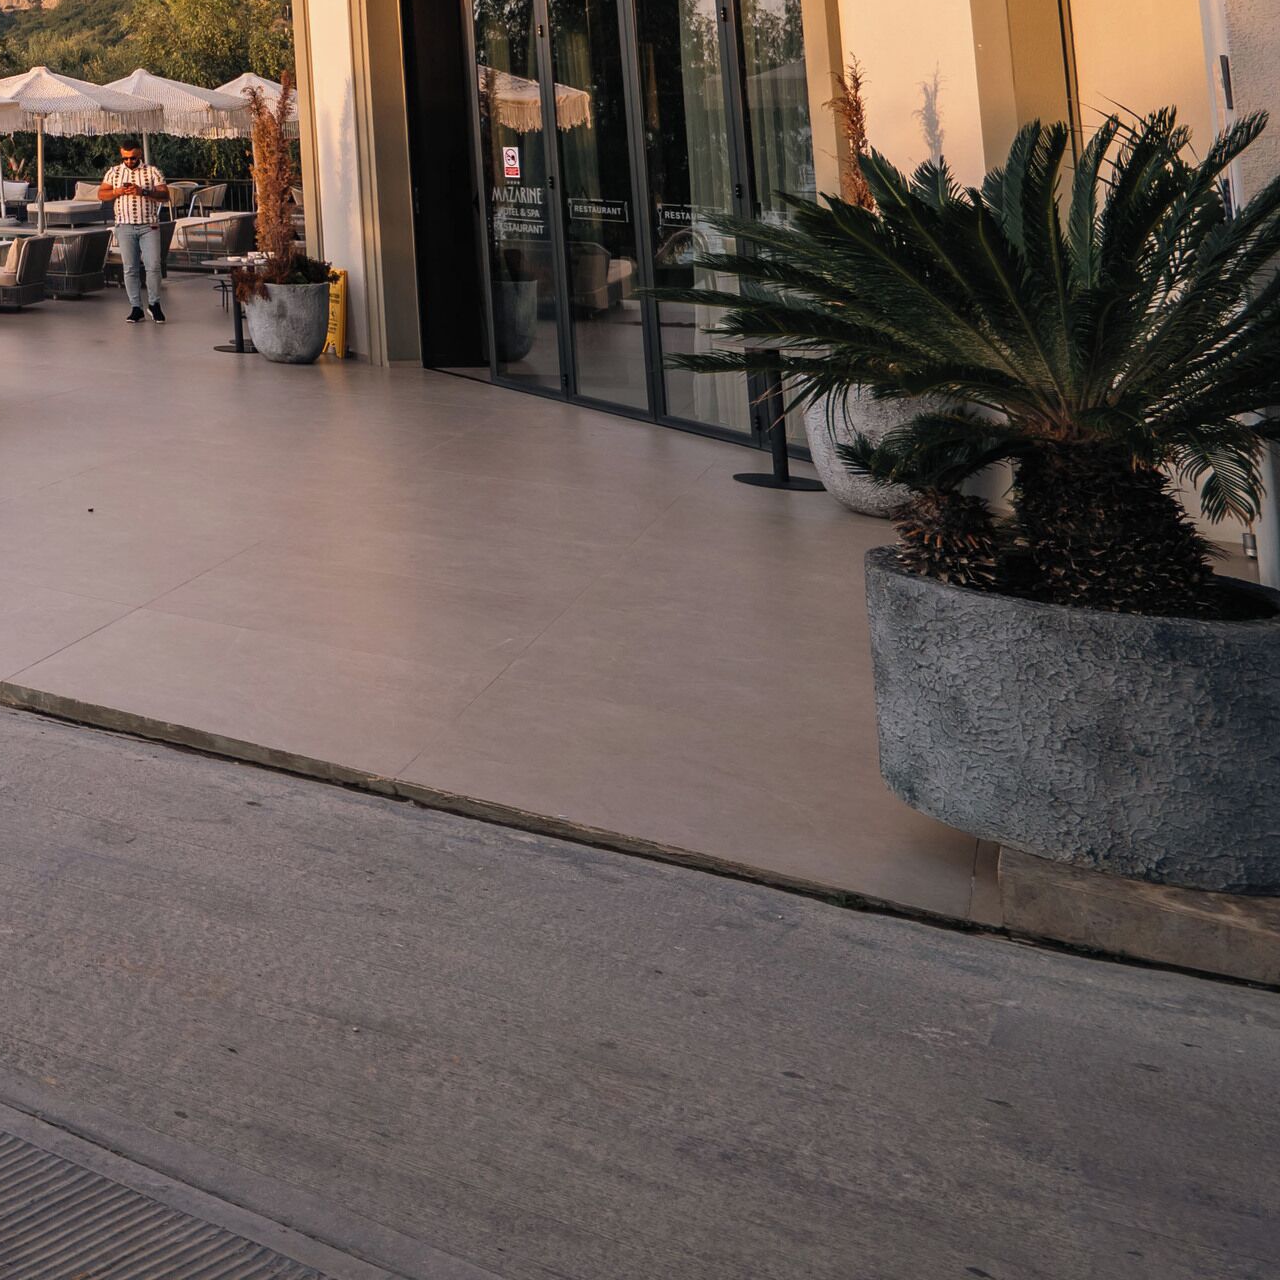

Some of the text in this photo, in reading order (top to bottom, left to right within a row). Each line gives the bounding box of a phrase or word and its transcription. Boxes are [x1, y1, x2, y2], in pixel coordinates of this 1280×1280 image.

[492, 186, 543, 204] MAZARINE
[527, 208, 540, 218] SPA
[574, 205, 621, 215] RESTAURANT
[664, 210, 697, 220] RESTAU
